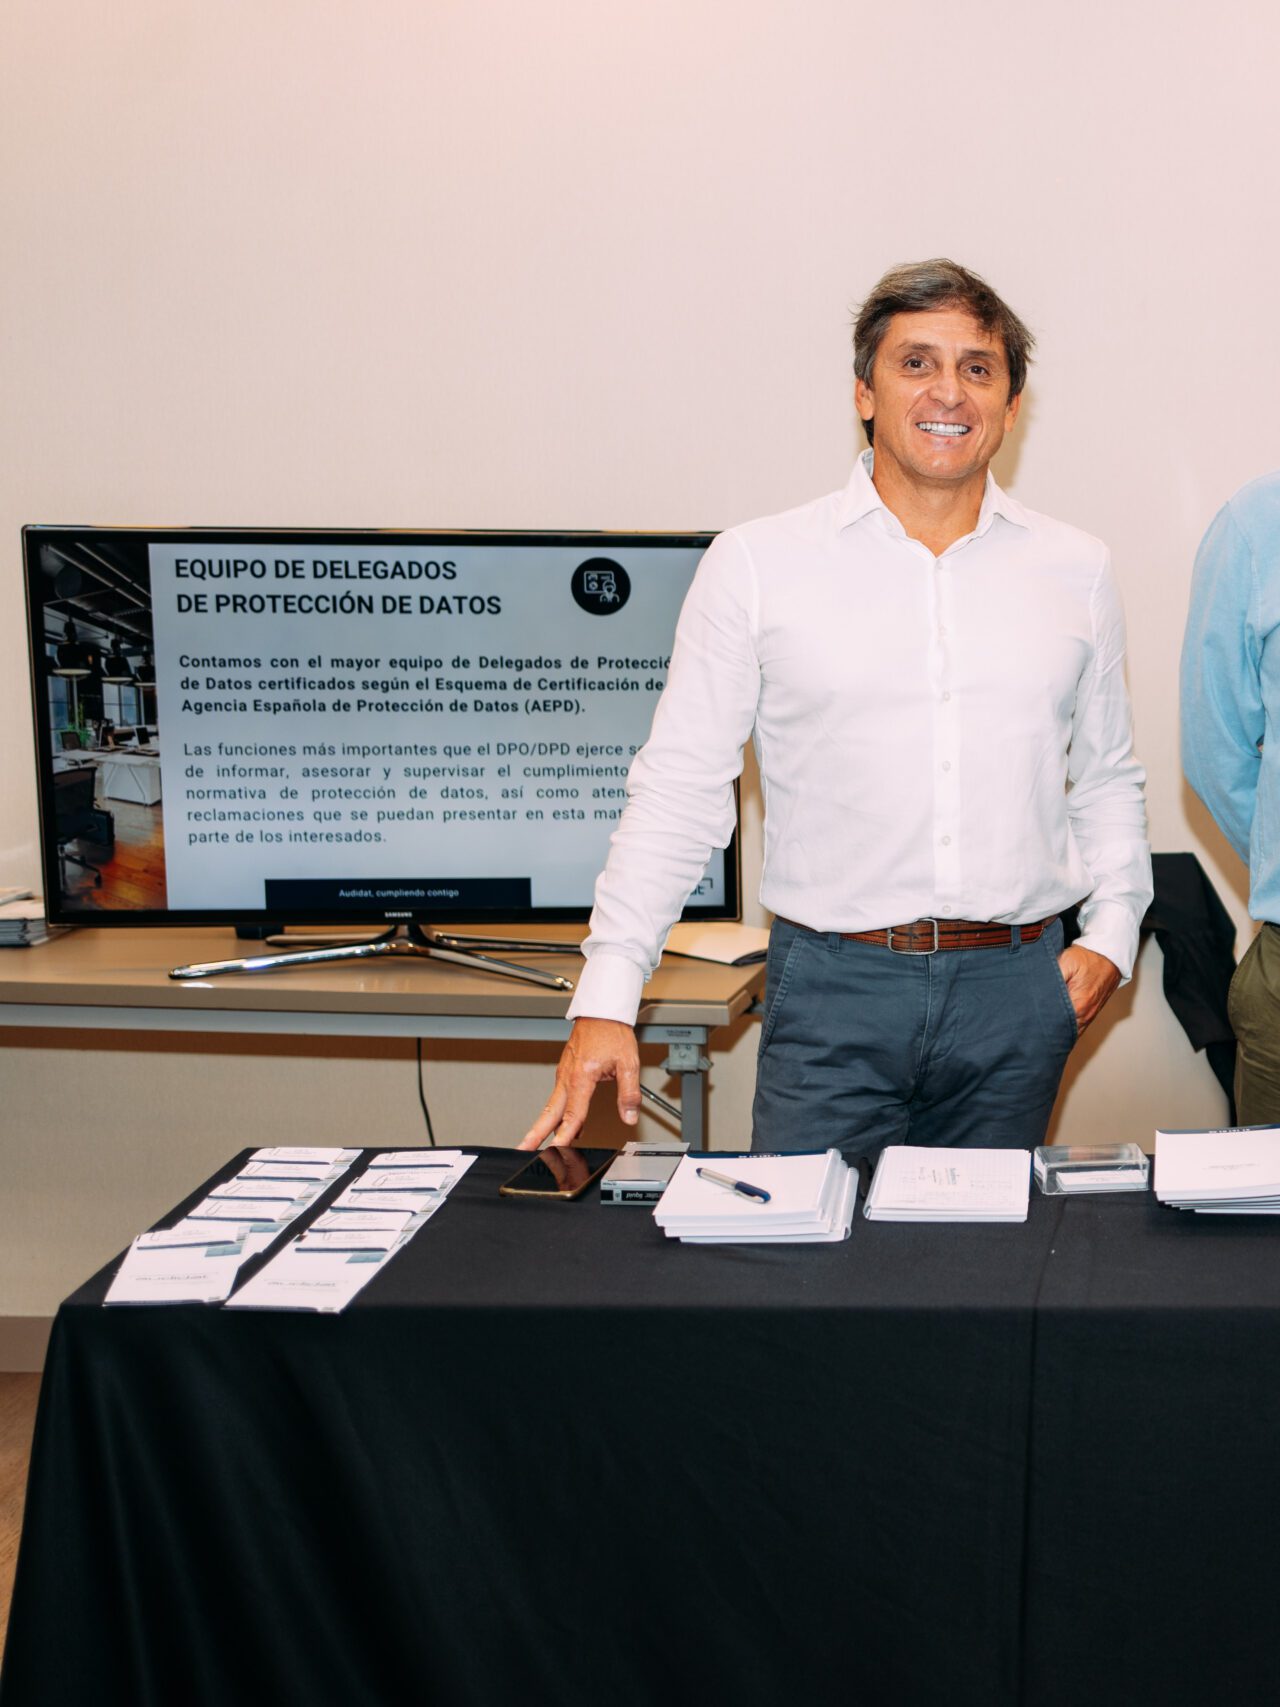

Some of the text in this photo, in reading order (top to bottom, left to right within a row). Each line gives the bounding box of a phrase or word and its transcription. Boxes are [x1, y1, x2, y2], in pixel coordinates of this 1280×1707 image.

[175, 559, 456, 580] EQUIPO DE DELEGADOS
[177, 591, 501, 614] DE PROTECCIÓN DE DATOS
[179, 655, 672, 671] Contamos con el mayor equipo de Delegados de Protecció
[181, 677, 663, 693] de Datos certificados según el Esquema de Certificación de
[182, 699, 584, 715] Agencia Española de Protección de Datos (AEPD).
[184, 744, 211, 755] Las
[218, 742, 296, 755] funciones
[303, 743, 335, 755] más
[342, 743, 437, 758] importantes
[443, 746, 471, 758] que
[478, 743, 490, 755] el
[497, 743, 570, 755] DPO/DPD
[576, 745, 623, 758] ejerce
[185, 764, 628, 780] de informar, asesorar y supervisar el cumplimiento
[186, 787, 266, 799] normativa
[280, 786, 298, 799] de
[312, 786, 395, 802] protección
[409, 786, 427, 799] de
[441, 786, 488, 800] datos,
[501, 786, 523, 798] así
[537, 789, 579, 798] como
[188, 808, 623, 823] reclamaciones que se puedan presentar en esta mat
[189, 830, 385, 846] parte de los interesados.
[376, 889, 425, 897] cumpliendo
[427, 890, 459, 898] contigo
